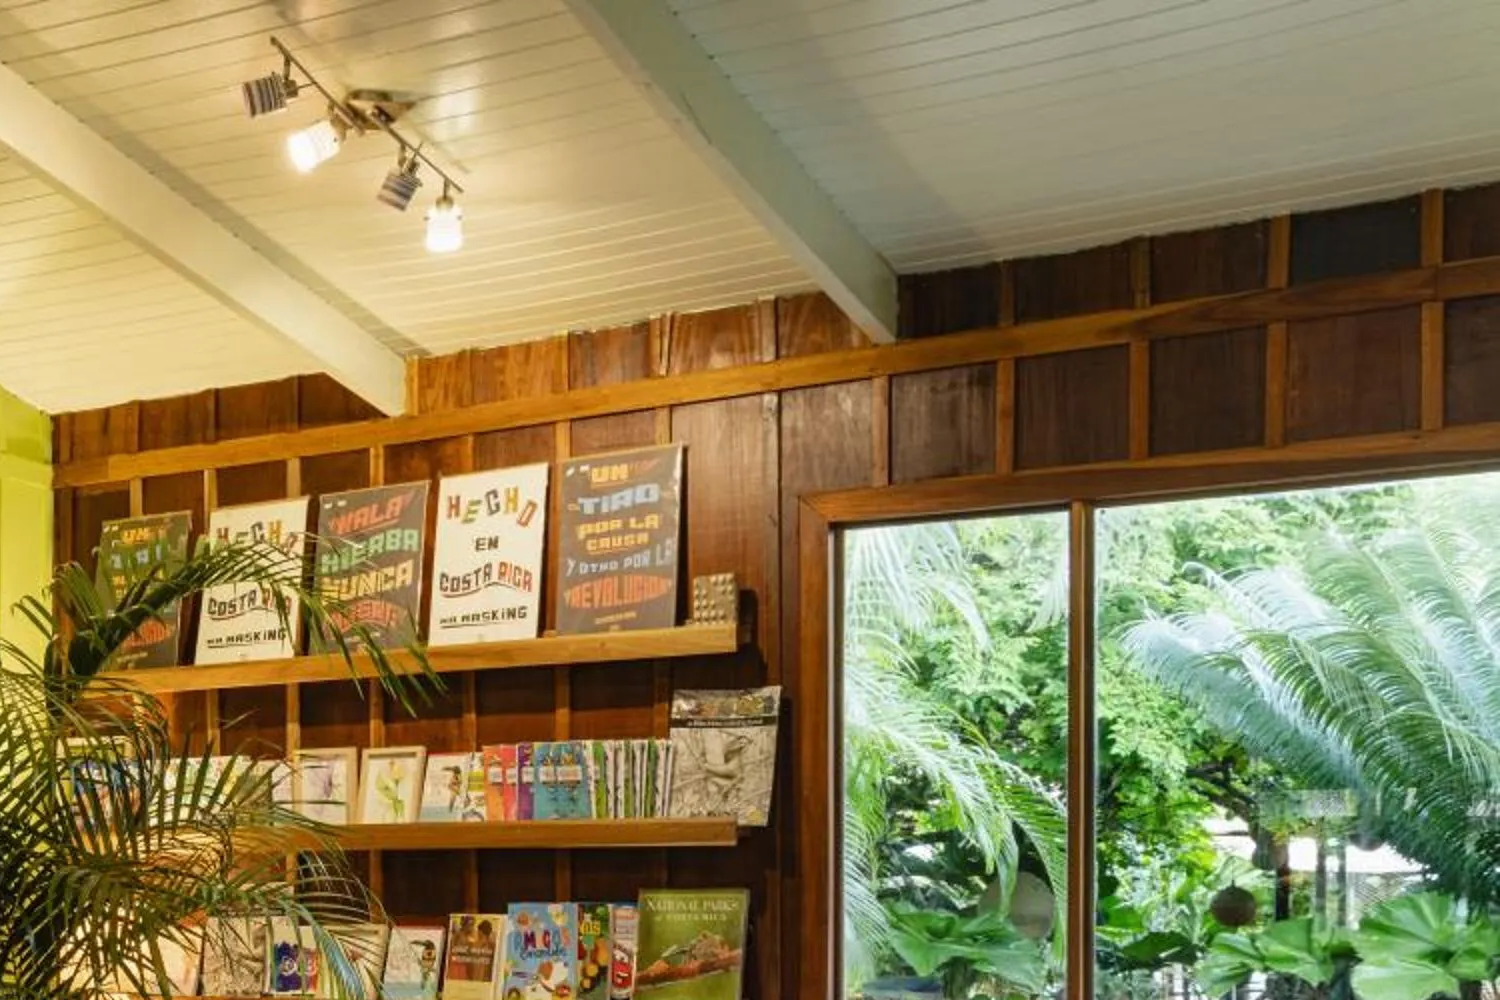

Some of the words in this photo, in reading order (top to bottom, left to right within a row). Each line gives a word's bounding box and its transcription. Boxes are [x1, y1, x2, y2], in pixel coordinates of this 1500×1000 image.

[591, 463, 628, 483] UN
[332, 496, 403, 534] MALA
[447, 486, 538, 528] HECHO
[577, 519, 623, 540] POR
[630, 513, 660, 530] LA
[321, 528, 419, 574] HIERBA
[475, 536, 499, 552] EN
[586, 532, 650, 551] CAUSA
[623, 551, 651, 569] POR
[321, 559, 414, 603] NUNCA
[439, 562, 493, 593] COSTA
[498, 561, 533, 592] RICA
[207, 588, 257, 617] COSTA
[262, 587, 293, 616] RIA
[461, 606, 528, 624] MASKING
[226, 629, 287, 644] MASKING
